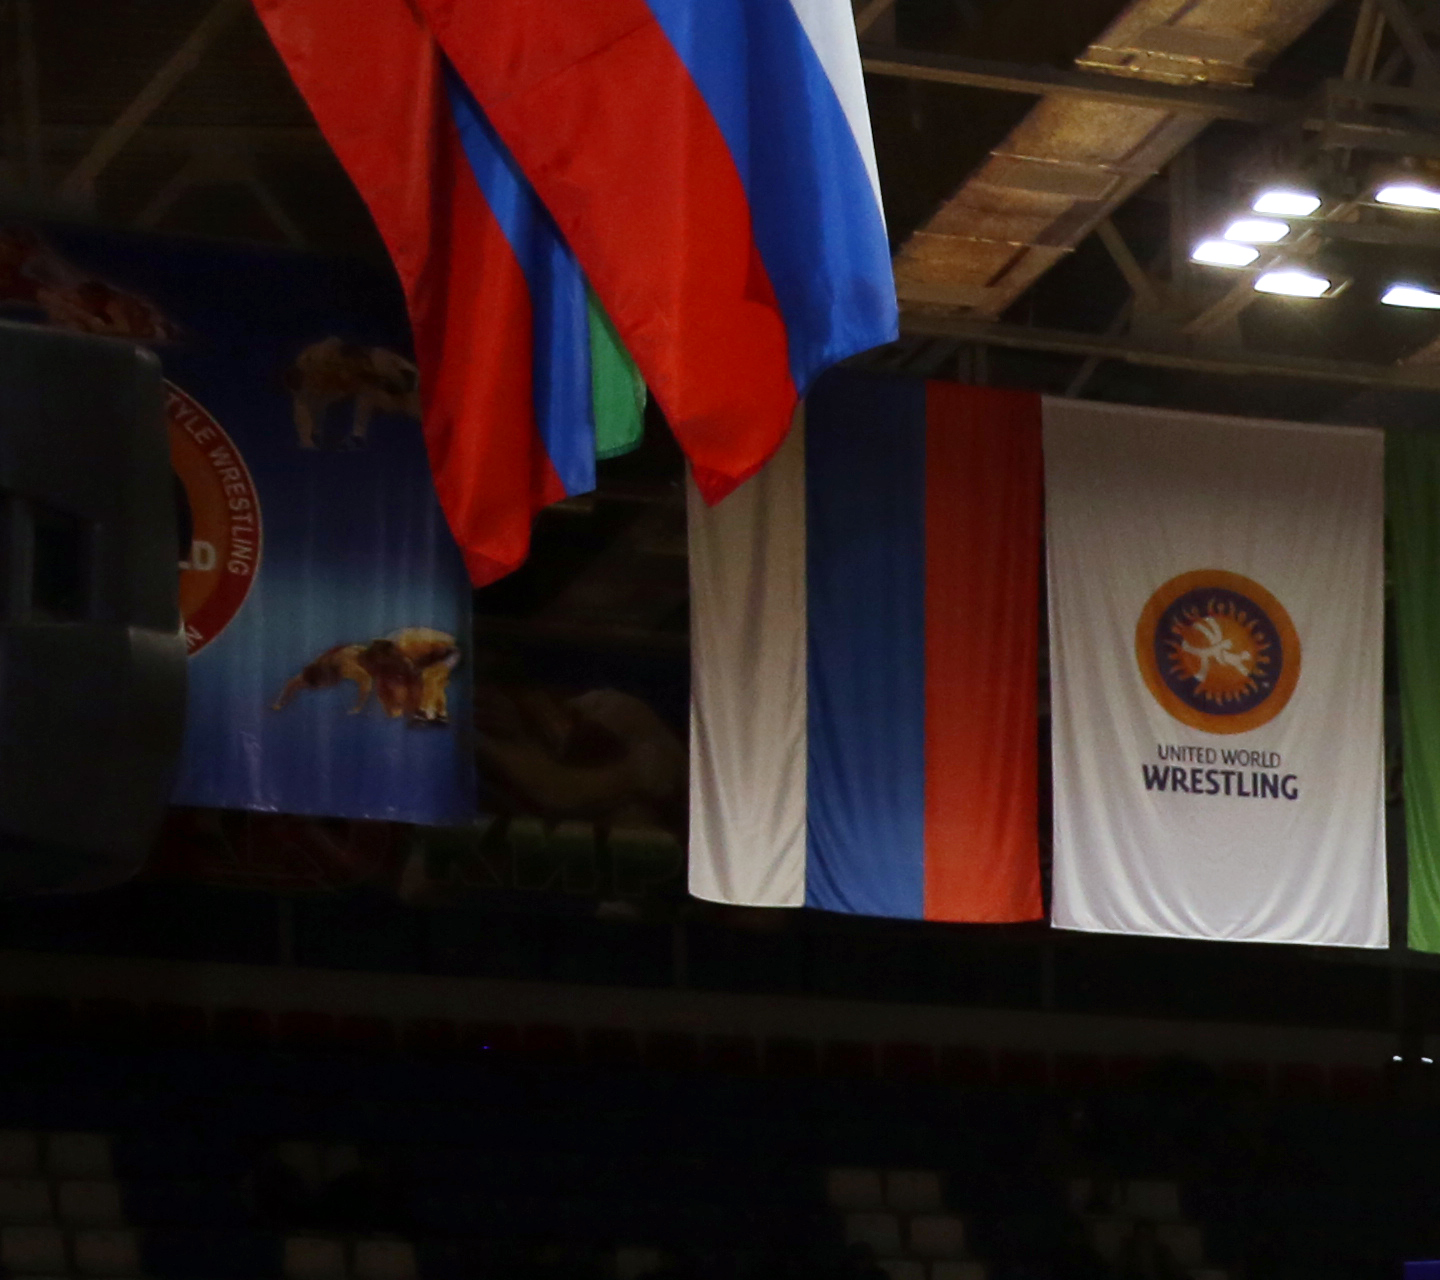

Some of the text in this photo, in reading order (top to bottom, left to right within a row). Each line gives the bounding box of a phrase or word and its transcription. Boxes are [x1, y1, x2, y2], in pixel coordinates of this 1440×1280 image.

[208, 446, 253, 576] WRESTLING
[1157, 743, 1281, 768] UNITED WORLD
[1142, 764, 1299, 800] WRESTLING
